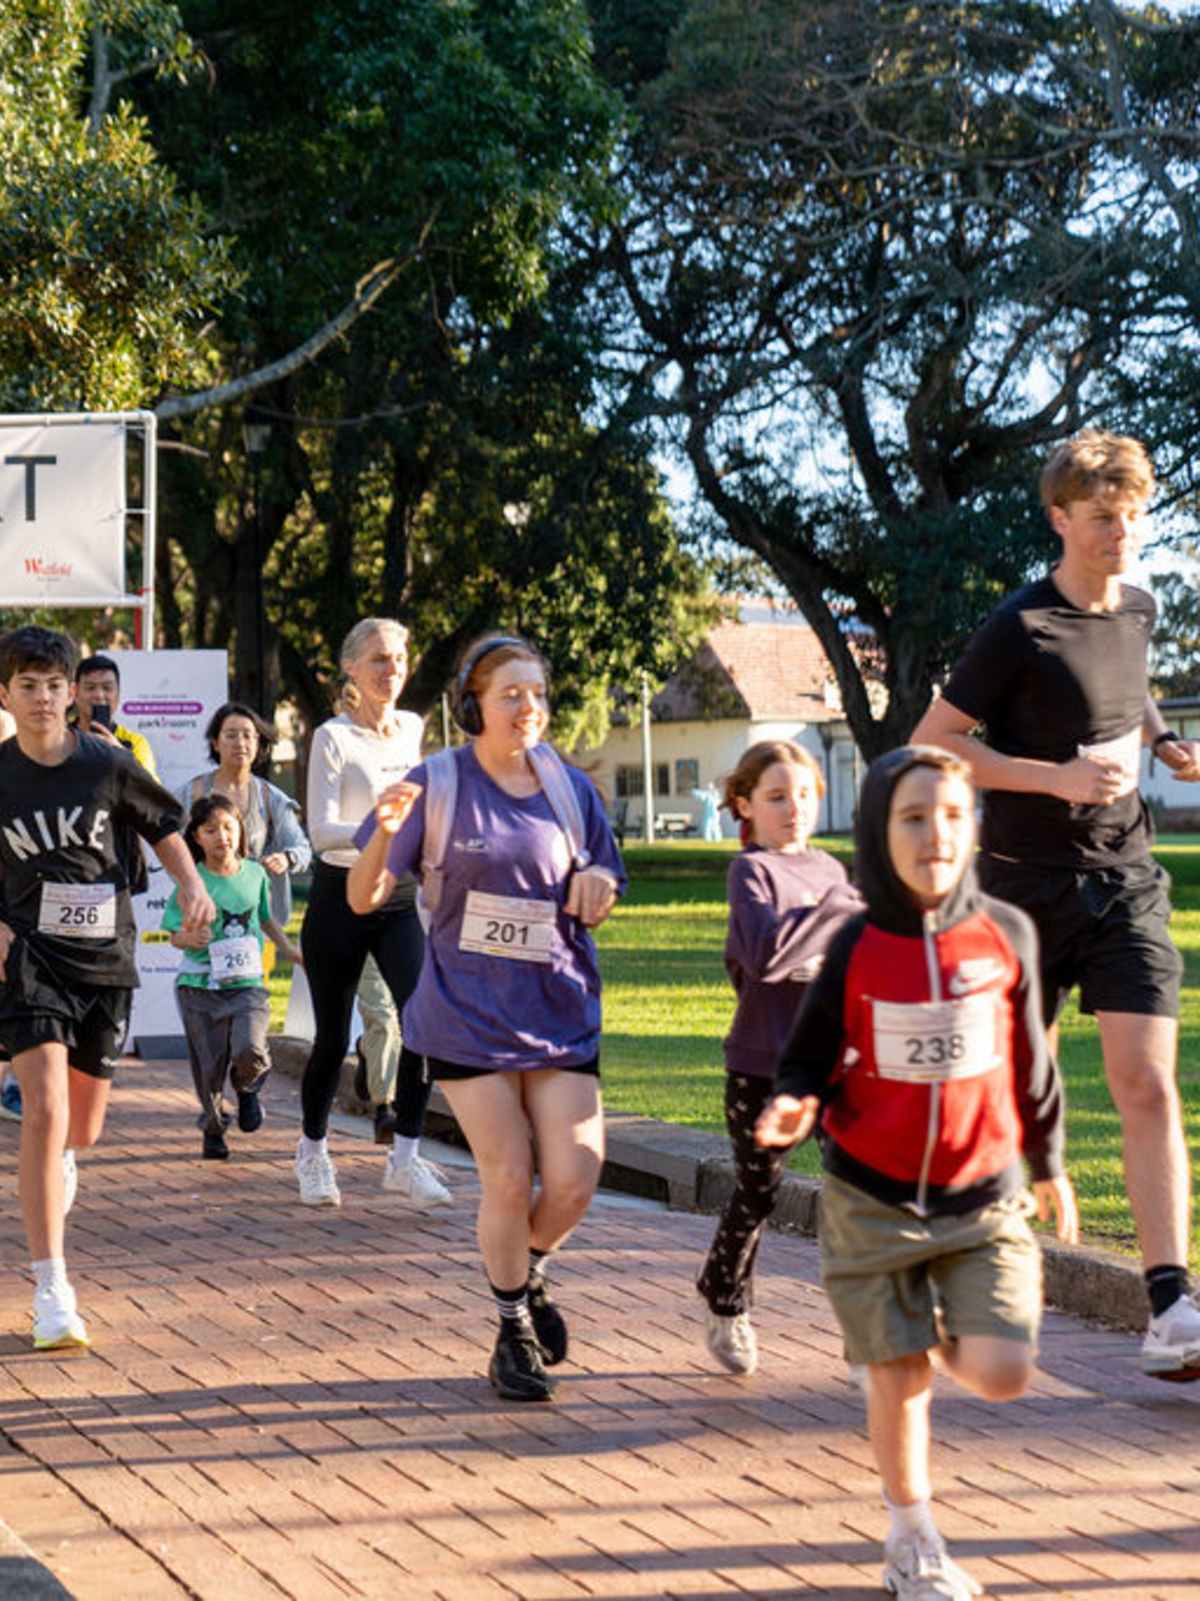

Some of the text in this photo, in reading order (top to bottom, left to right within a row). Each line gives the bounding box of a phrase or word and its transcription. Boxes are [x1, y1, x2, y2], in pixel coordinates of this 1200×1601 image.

[2, 806, 110, 861] NIKE
[59, 906, 99, 924] 256
[484, 920, 529, 945] 201
[905, 1034, 966, 1065] 238
